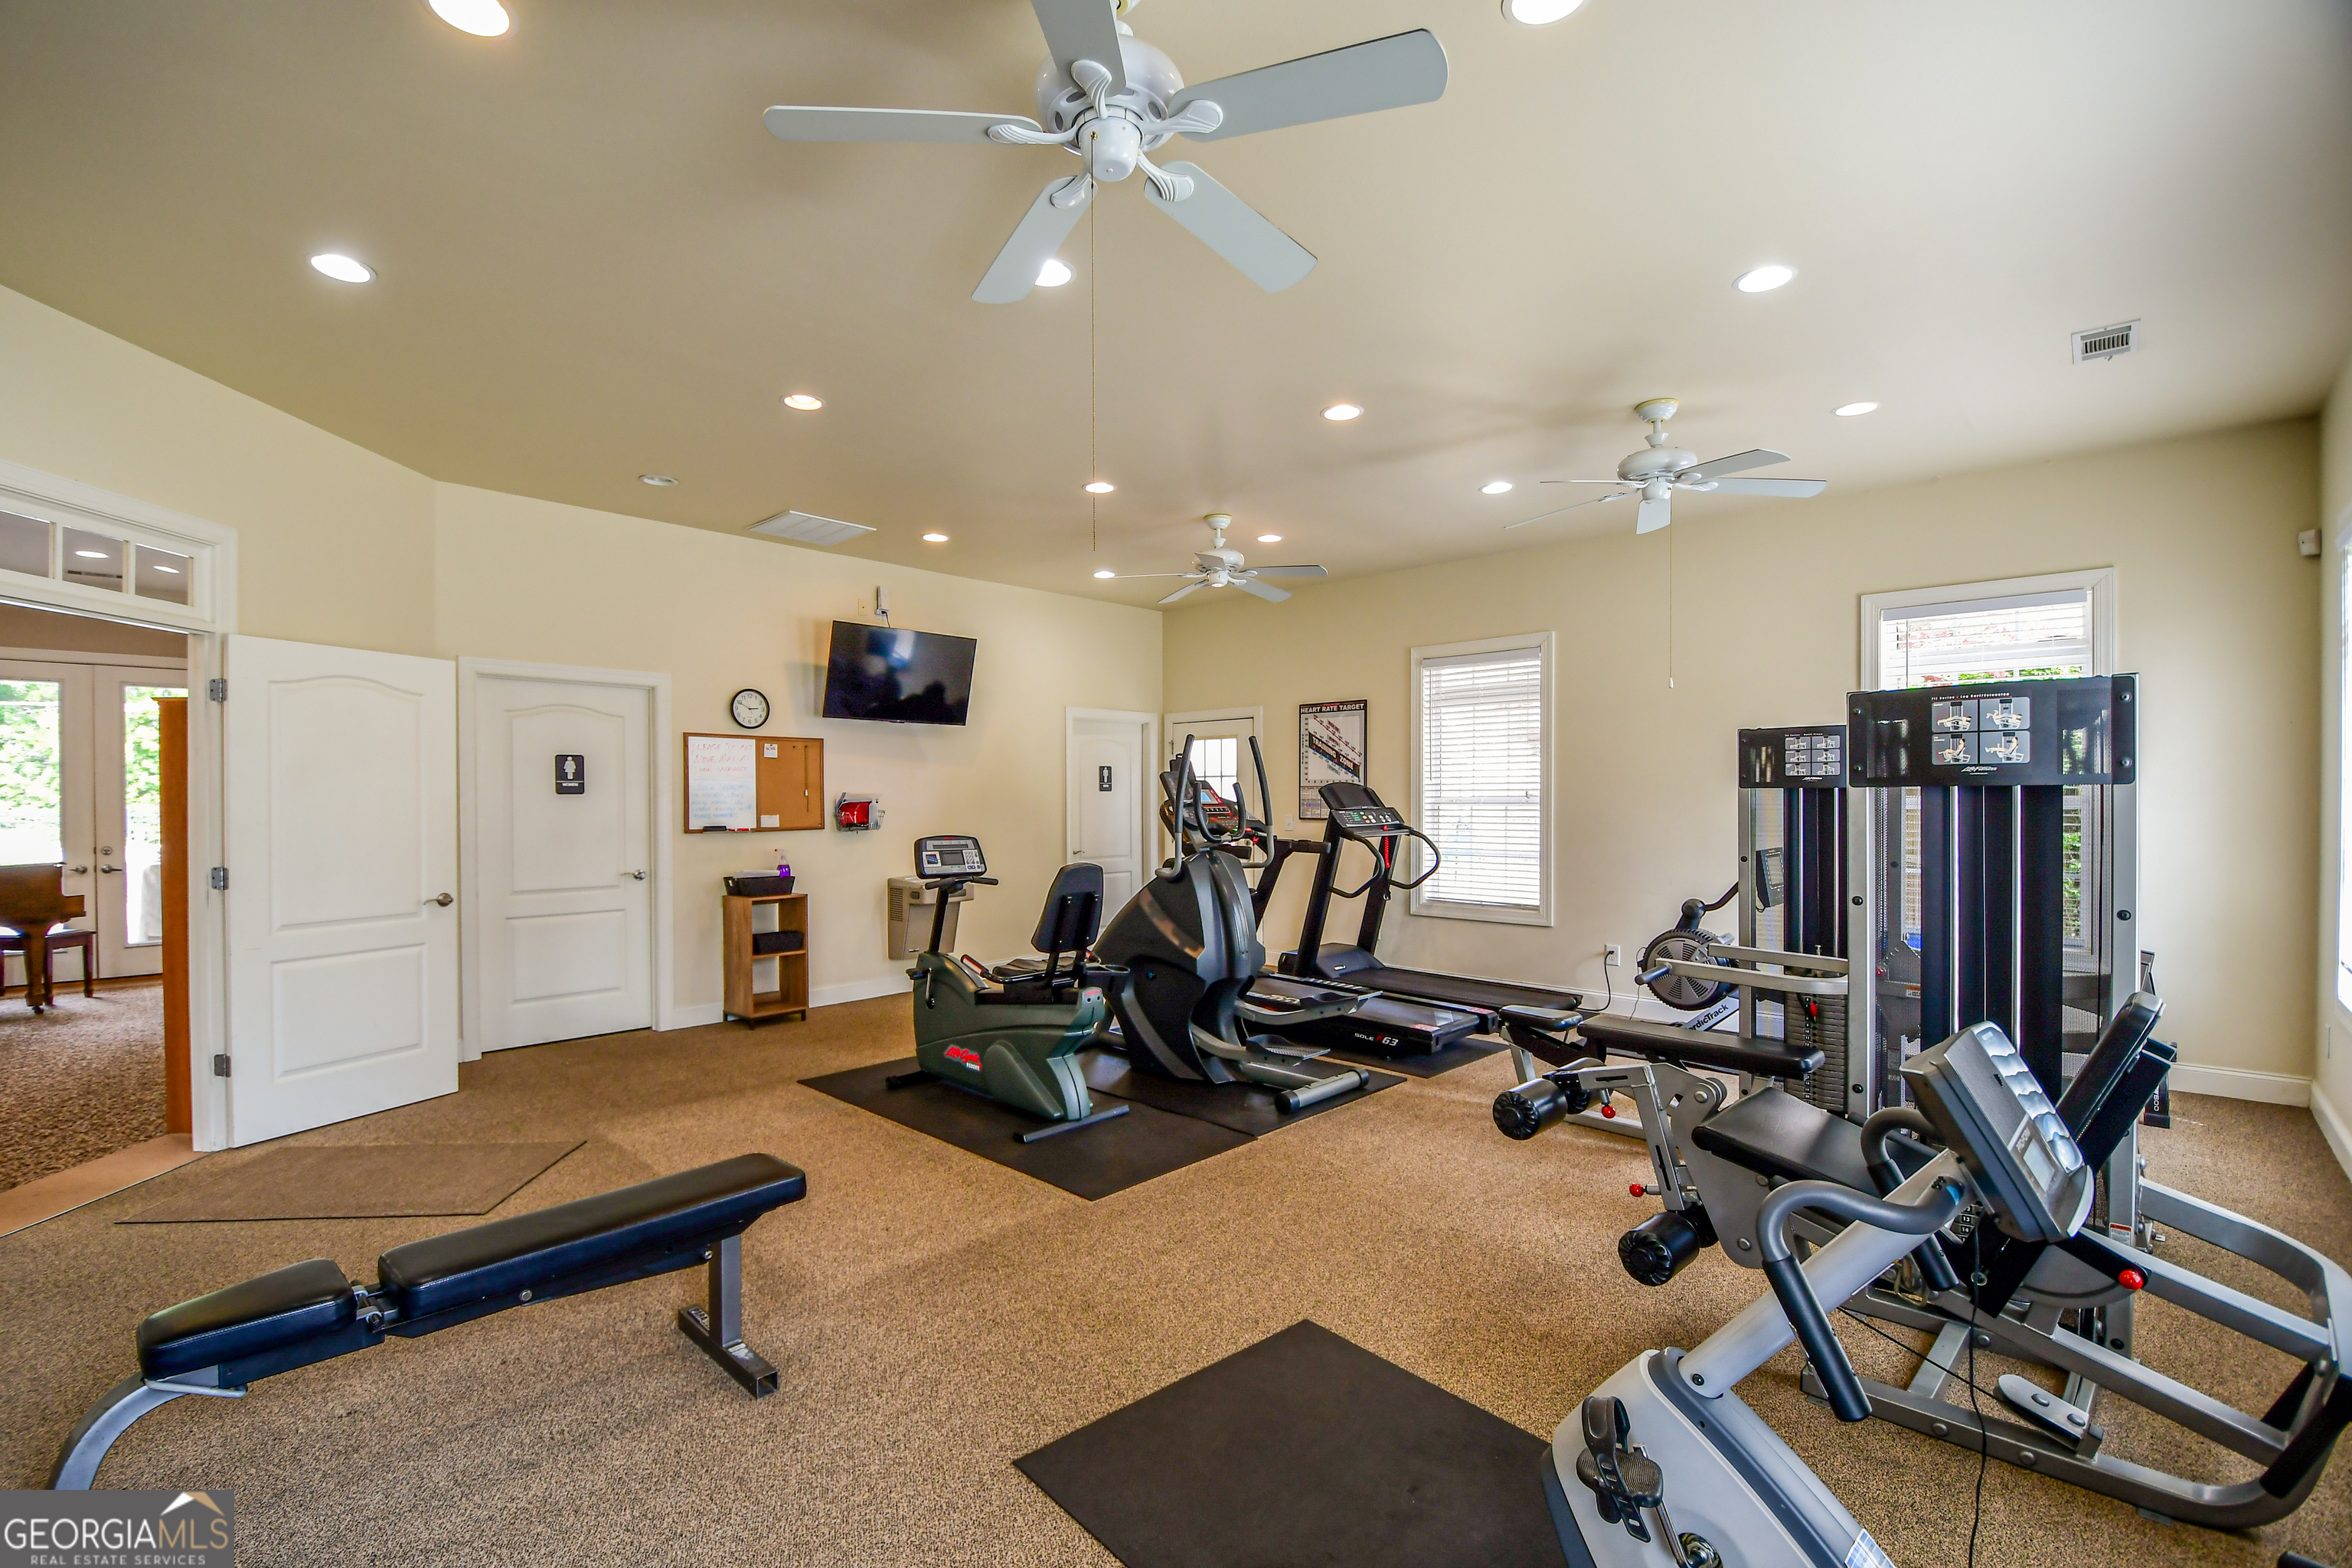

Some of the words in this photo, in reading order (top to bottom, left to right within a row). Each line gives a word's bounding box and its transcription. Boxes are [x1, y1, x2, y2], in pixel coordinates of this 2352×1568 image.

[1312, 736, 1337, 758] TRAINING
[1340, 755, 1354, 770] ZONE
[1687, 1004, 1729, 1030] ordicTrack
[1354, 1033, 1374, 1041] SOLE
